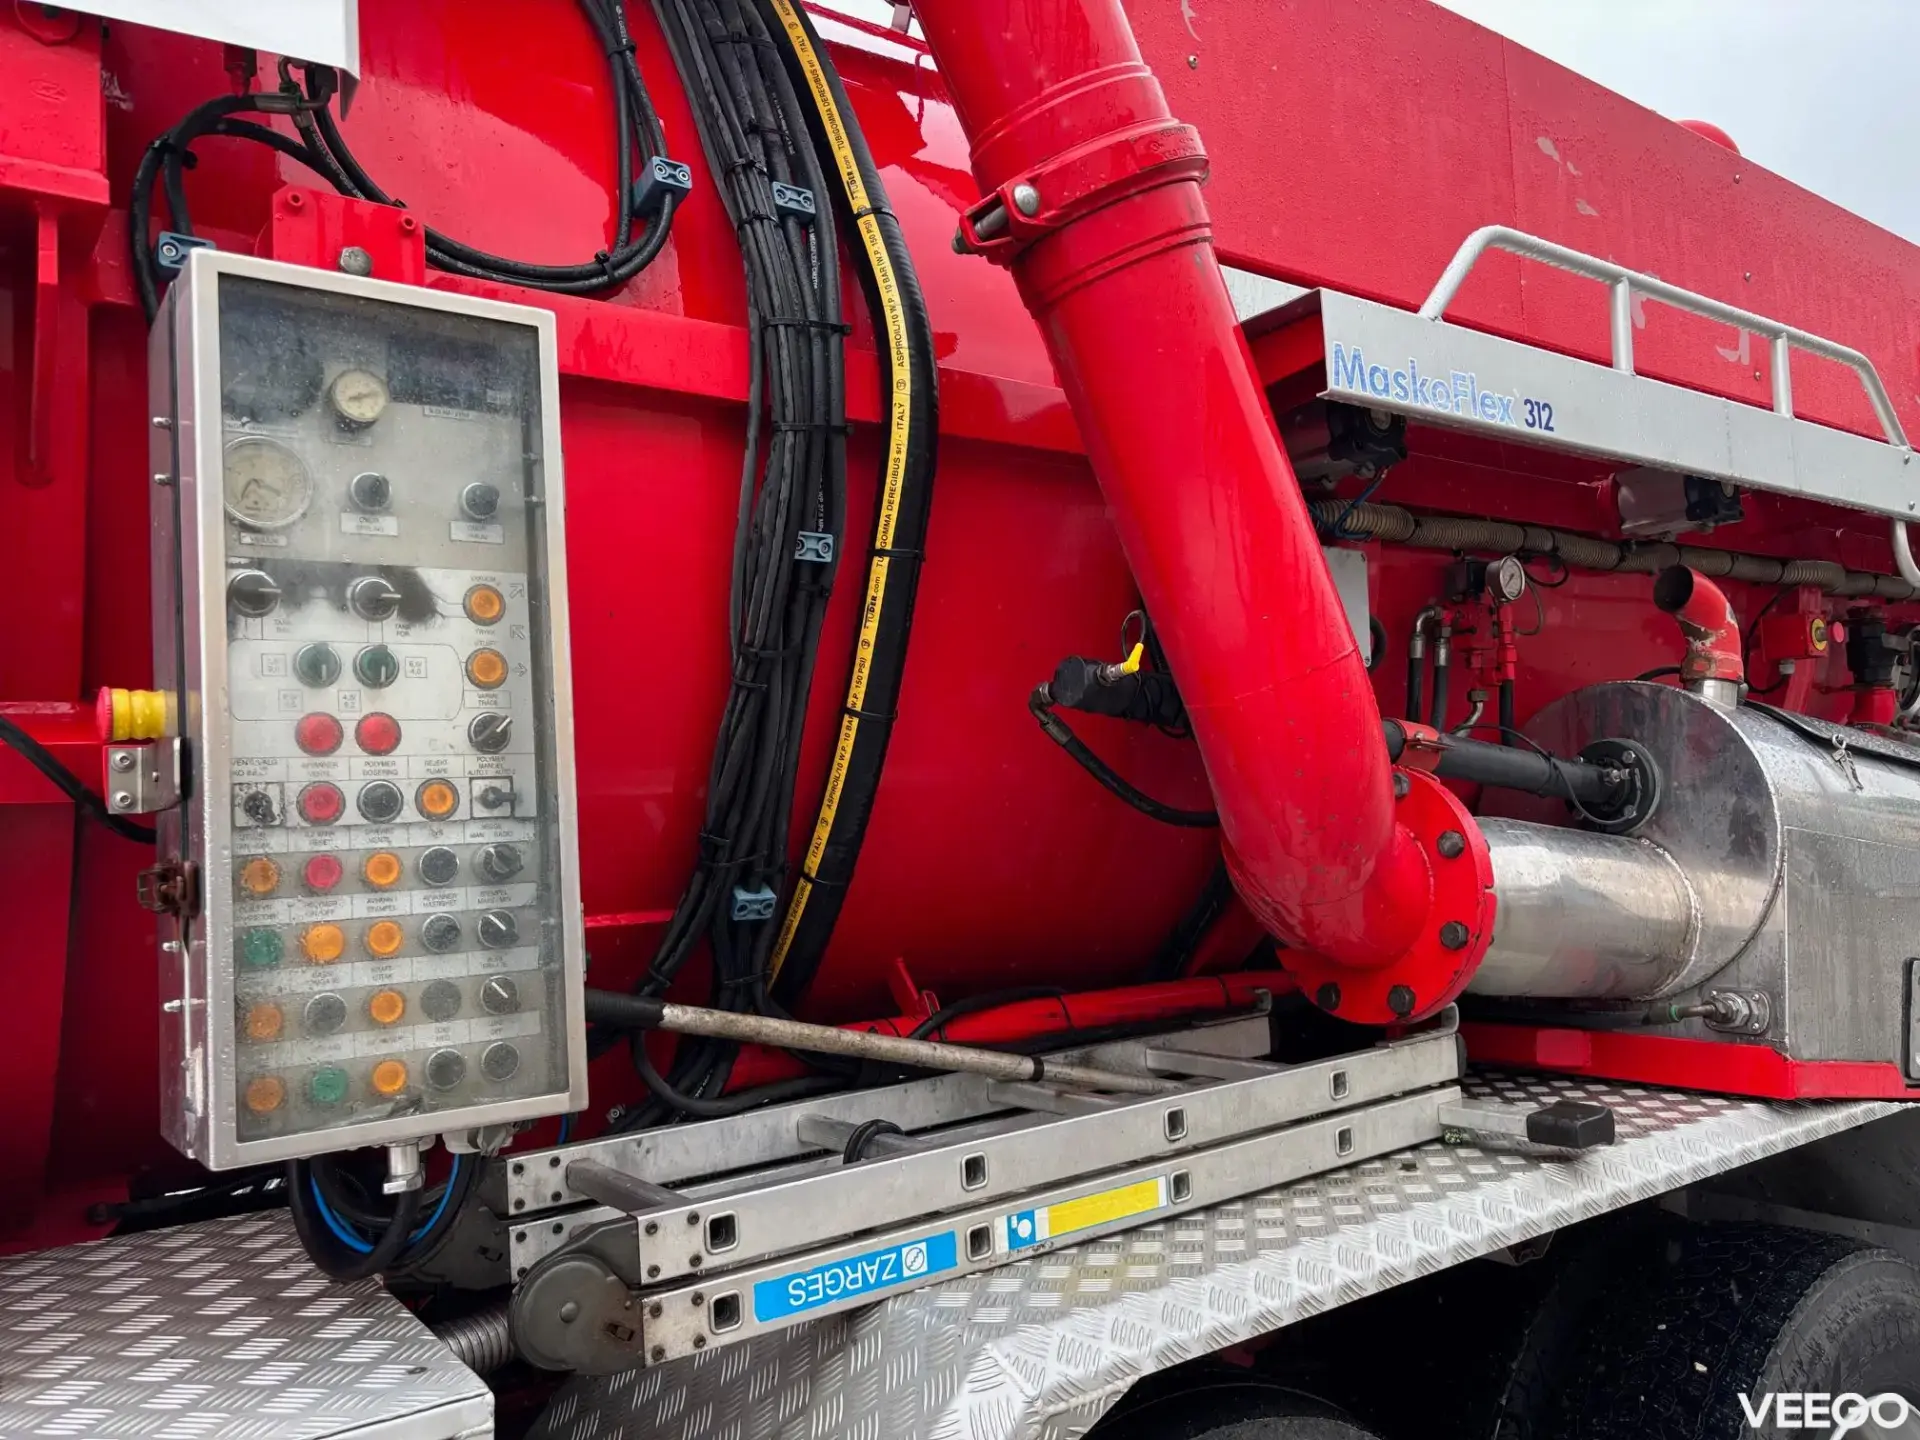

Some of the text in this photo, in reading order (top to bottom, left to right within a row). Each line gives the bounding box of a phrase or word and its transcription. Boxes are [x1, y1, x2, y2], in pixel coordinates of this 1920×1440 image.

[795, 35, 808, 53] ITALY
[810, 69, 830, 107] DEREGIBUS
[825, 108, 845, 150] TUBIGOMMA
[863, 219, 874, 234] PSI)
[868, 234, 879, 247] 150
[879, 266, 891, 284] BAR
[886, 283, 893, 294] 10
[891, 315, 905, 368] ASPIROIL/10
[1333, 342, 1555, 433] MaskoFlex 312
[896, 402, 905, 430] ITALY
[886, 455, 901, 511] DEREGIBUS
[858, 657, 867, 675] PSI)
[854, 675, 863, 690] 150
[843, 732, 850, 742] 10
[826, 762, 844, 810] ASPIROIL/10
[812, 835, 823, 858] ITALY
[790, 881, 808, 919] DEREGIBU
[788, 1252, 897, 1304] ZARGES
